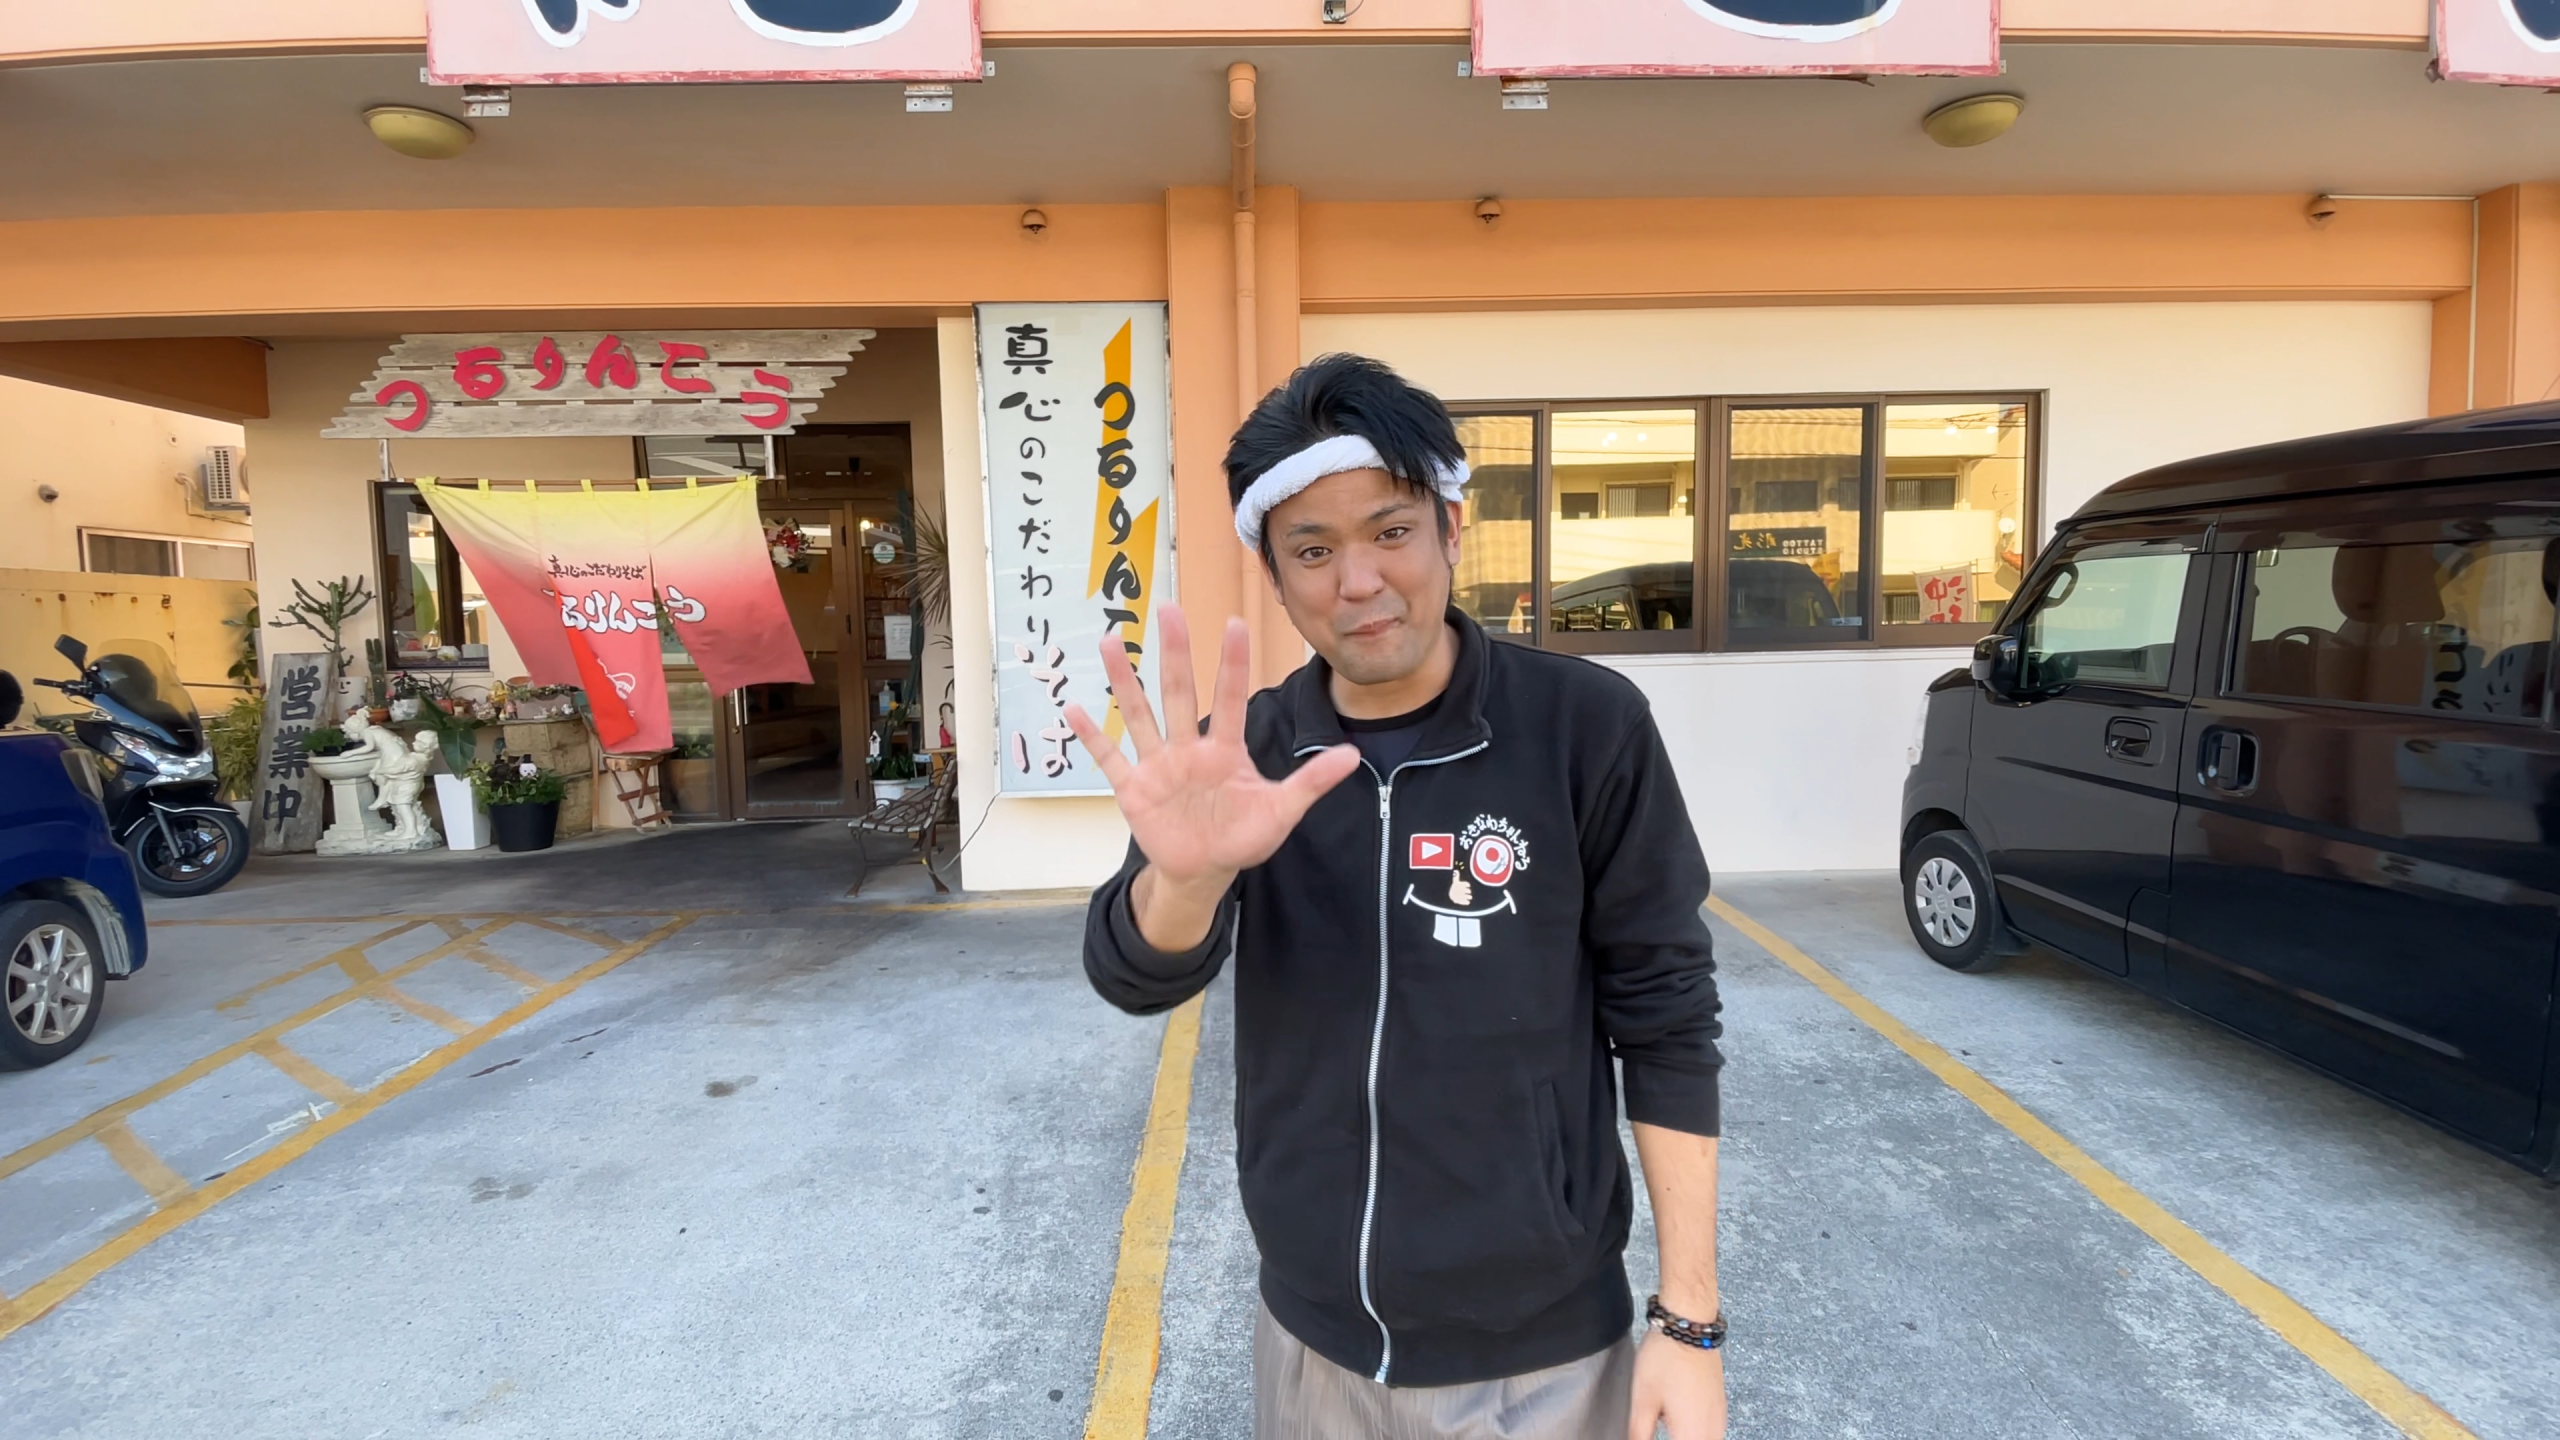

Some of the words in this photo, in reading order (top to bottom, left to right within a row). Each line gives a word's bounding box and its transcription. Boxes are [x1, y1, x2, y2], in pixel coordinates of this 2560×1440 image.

[376, 333, 791, 431] つるりんこう
[547, 554, 647, 580] 真心のこだわりそば
[541, 585, 706, 634] るりんこう
[262, 664, 322, 834] 営業中
[1459, 813, 1531, 871] おきなわちゃんねる
